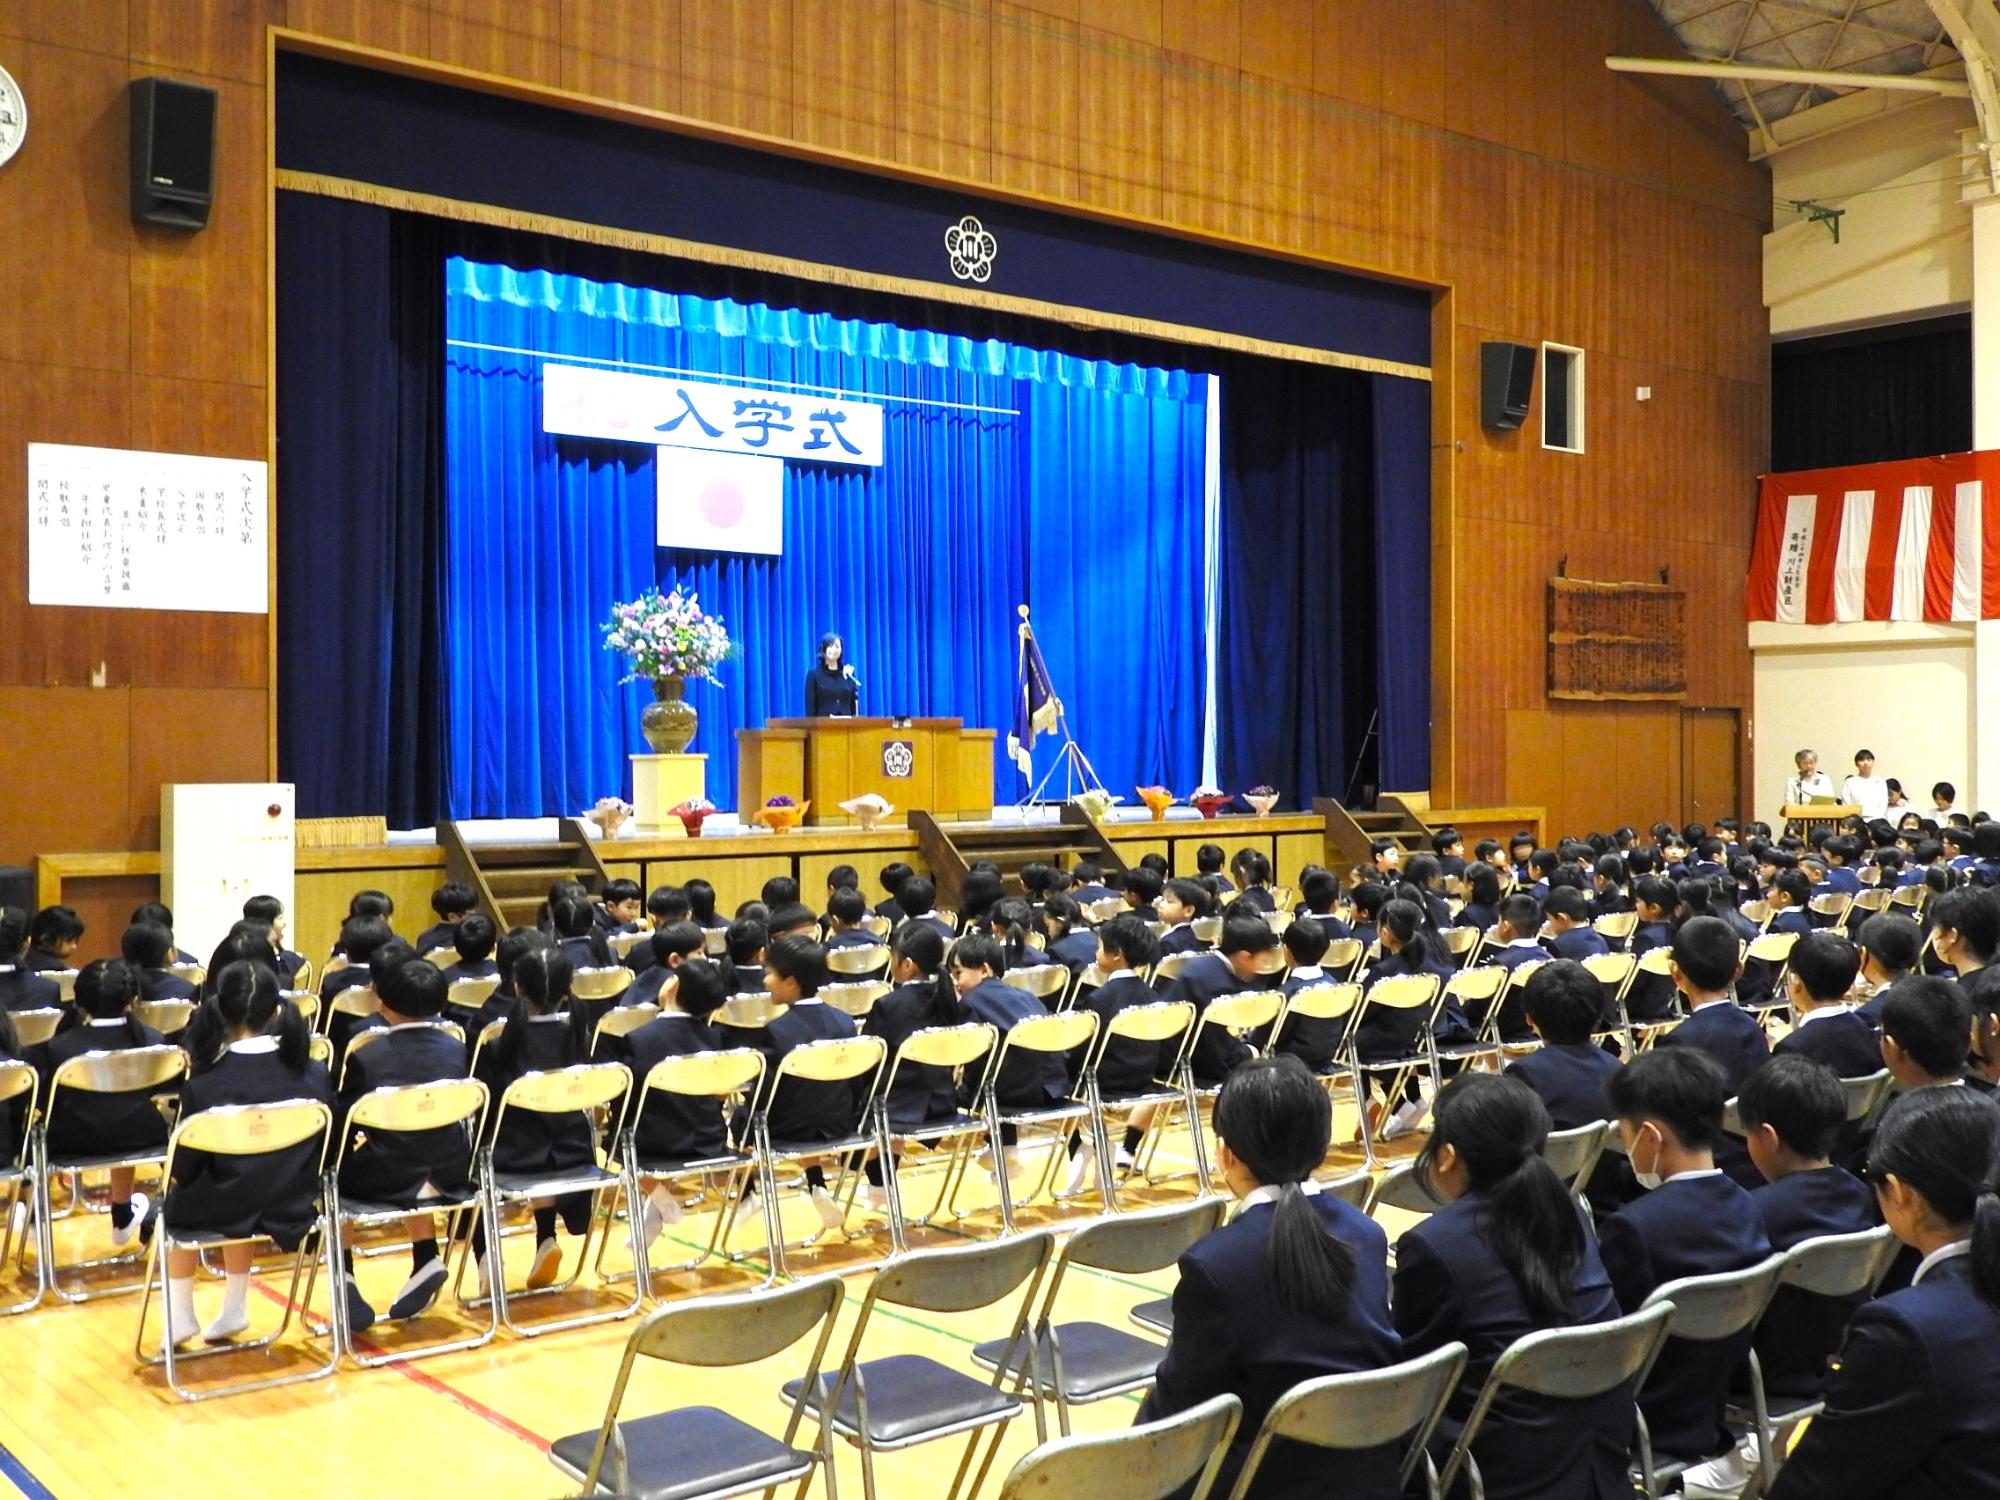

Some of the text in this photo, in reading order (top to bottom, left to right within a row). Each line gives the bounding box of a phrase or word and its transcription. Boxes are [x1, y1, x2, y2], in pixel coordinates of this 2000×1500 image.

[654, 389, 862, 455] 入学式
[239, 472, 254, 545] 入学式次第
